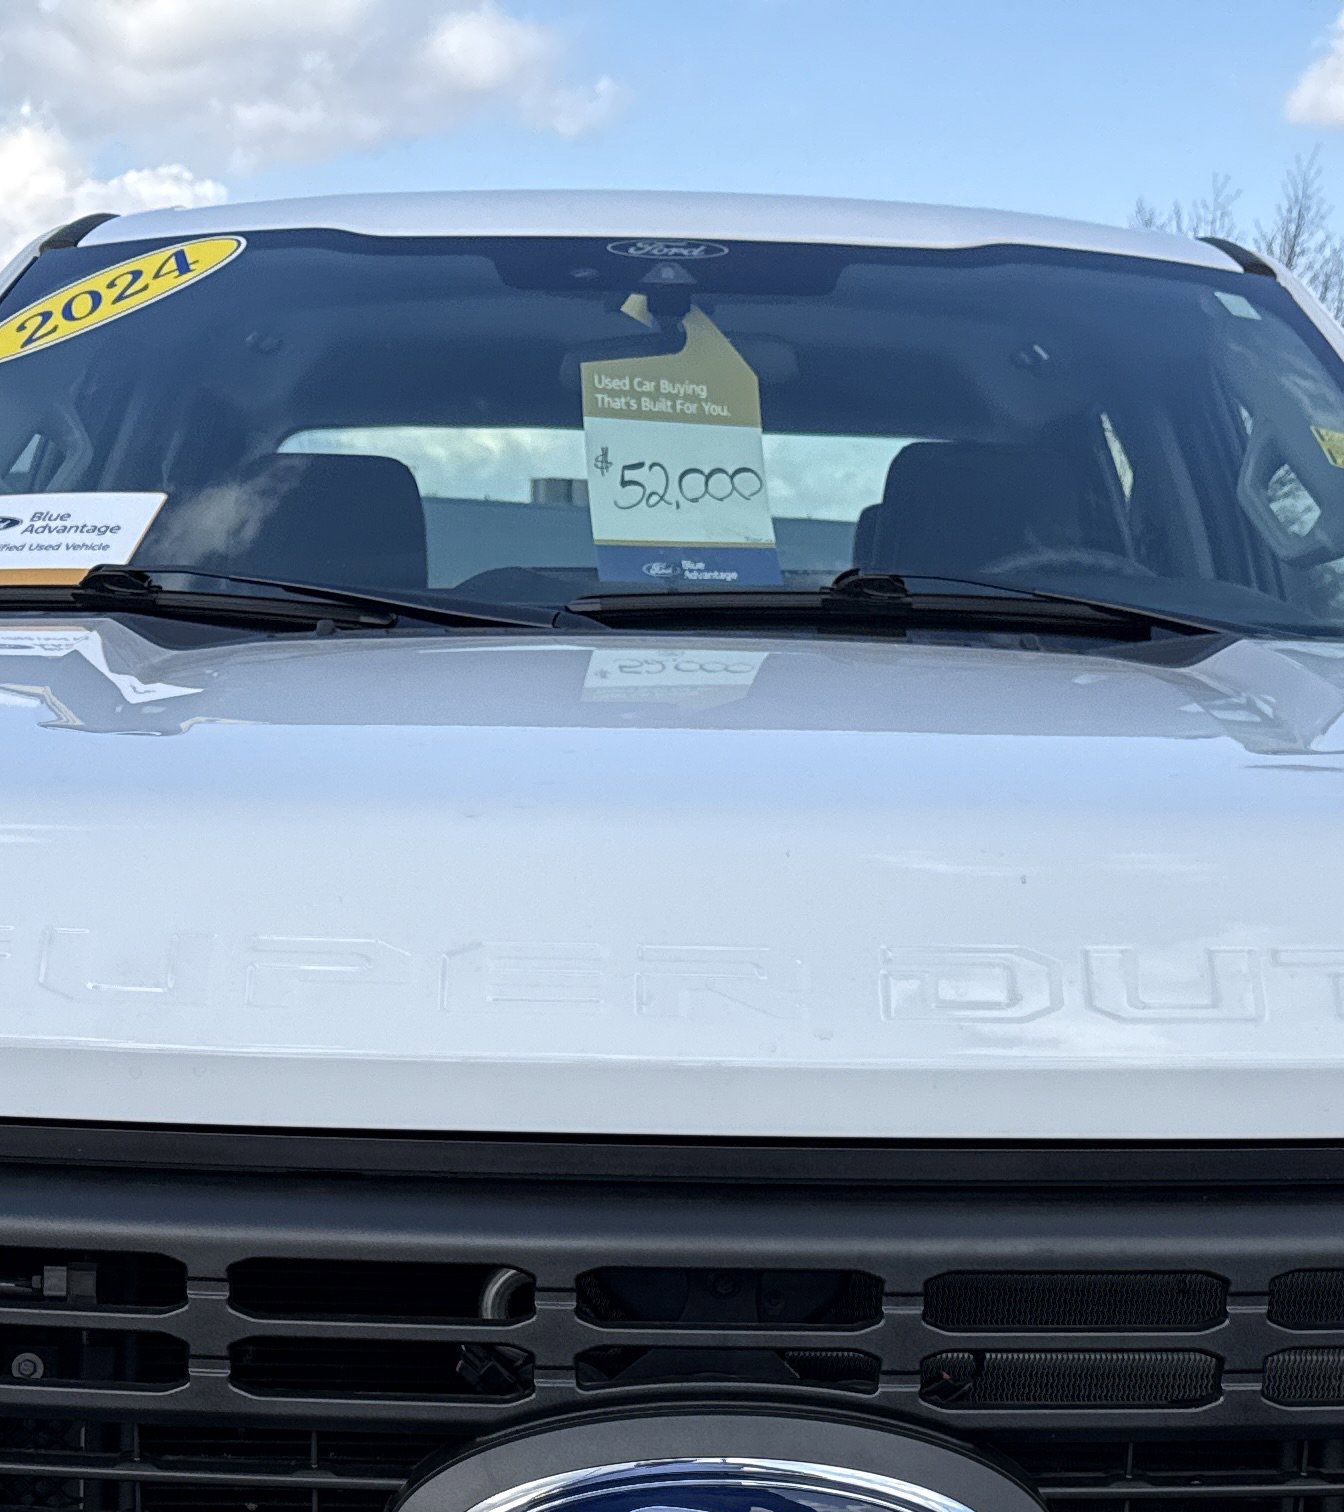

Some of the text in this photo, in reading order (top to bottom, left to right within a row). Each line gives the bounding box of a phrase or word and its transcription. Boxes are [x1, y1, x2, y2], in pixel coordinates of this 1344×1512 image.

[627, 240, 707, 256] Ford
[15, 248, 199, 349] 2024
[594, 374, 707, 399] Used Car Buying
[594, 394, 732, 417] That's Built For You.
[29, 511, 72, 522] Blue
[20, 523, 122, 536] Advantage
[28, 542, 62, 552] Used
[65, 541, 111, 551] Vehicle
[683, 570, 739, 582] Advantage
